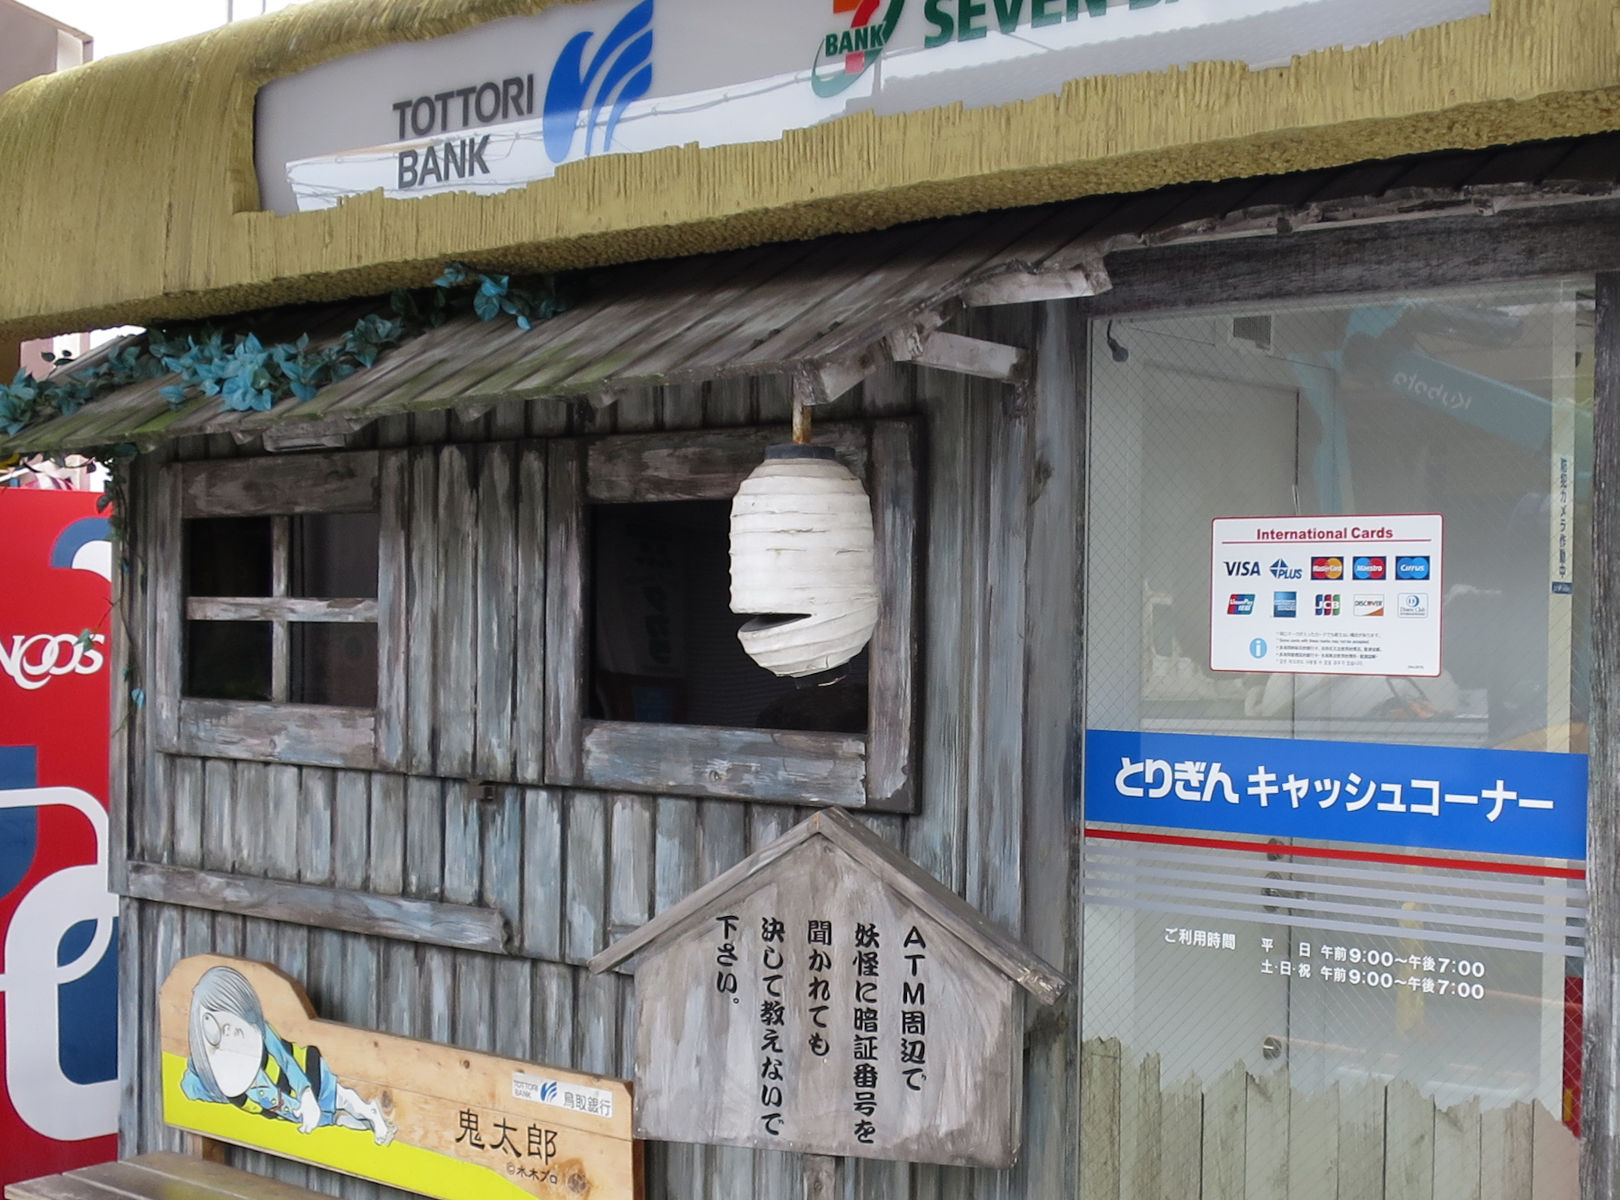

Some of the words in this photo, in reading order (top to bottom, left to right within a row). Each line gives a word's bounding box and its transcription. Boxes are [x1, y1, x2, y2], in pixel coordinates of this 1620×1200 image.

[825, 21, 886, 57] BANK
[392, 74, 535, 138] TOTTORI
[399, 134, 491, 189] BANK
[1257, 528, 1347, 540] International
[1351, 527, 1393, 539] Cards
[1224, 561, 1261, 576] VISA
[1278, 568, 1302, 579] PLUS
[1357, 564, 1383, 572] Maestro
[1400, 564, 1425, 572] Cirrus
[1115, 757, 1239, 803] とりぎん
[1247, 765, 1554, 822] キャッシュコーナー
[716, 915, 740, 1004] 下さい。
[1164, 928, 1236, 950] ご利用時間
[807, 920, 832, 1056] 聞かれても
[901, 925, 927, 1091] ATM周辺で
[760, 917, 785, 1136] 決して教えないで
[853, 923, 880, 1144] 妖怪に暗証番号を
[564, 1091, 611, 1116] 鳥取銀行
[455, 1108, 558, 1165] 鬼太郎
